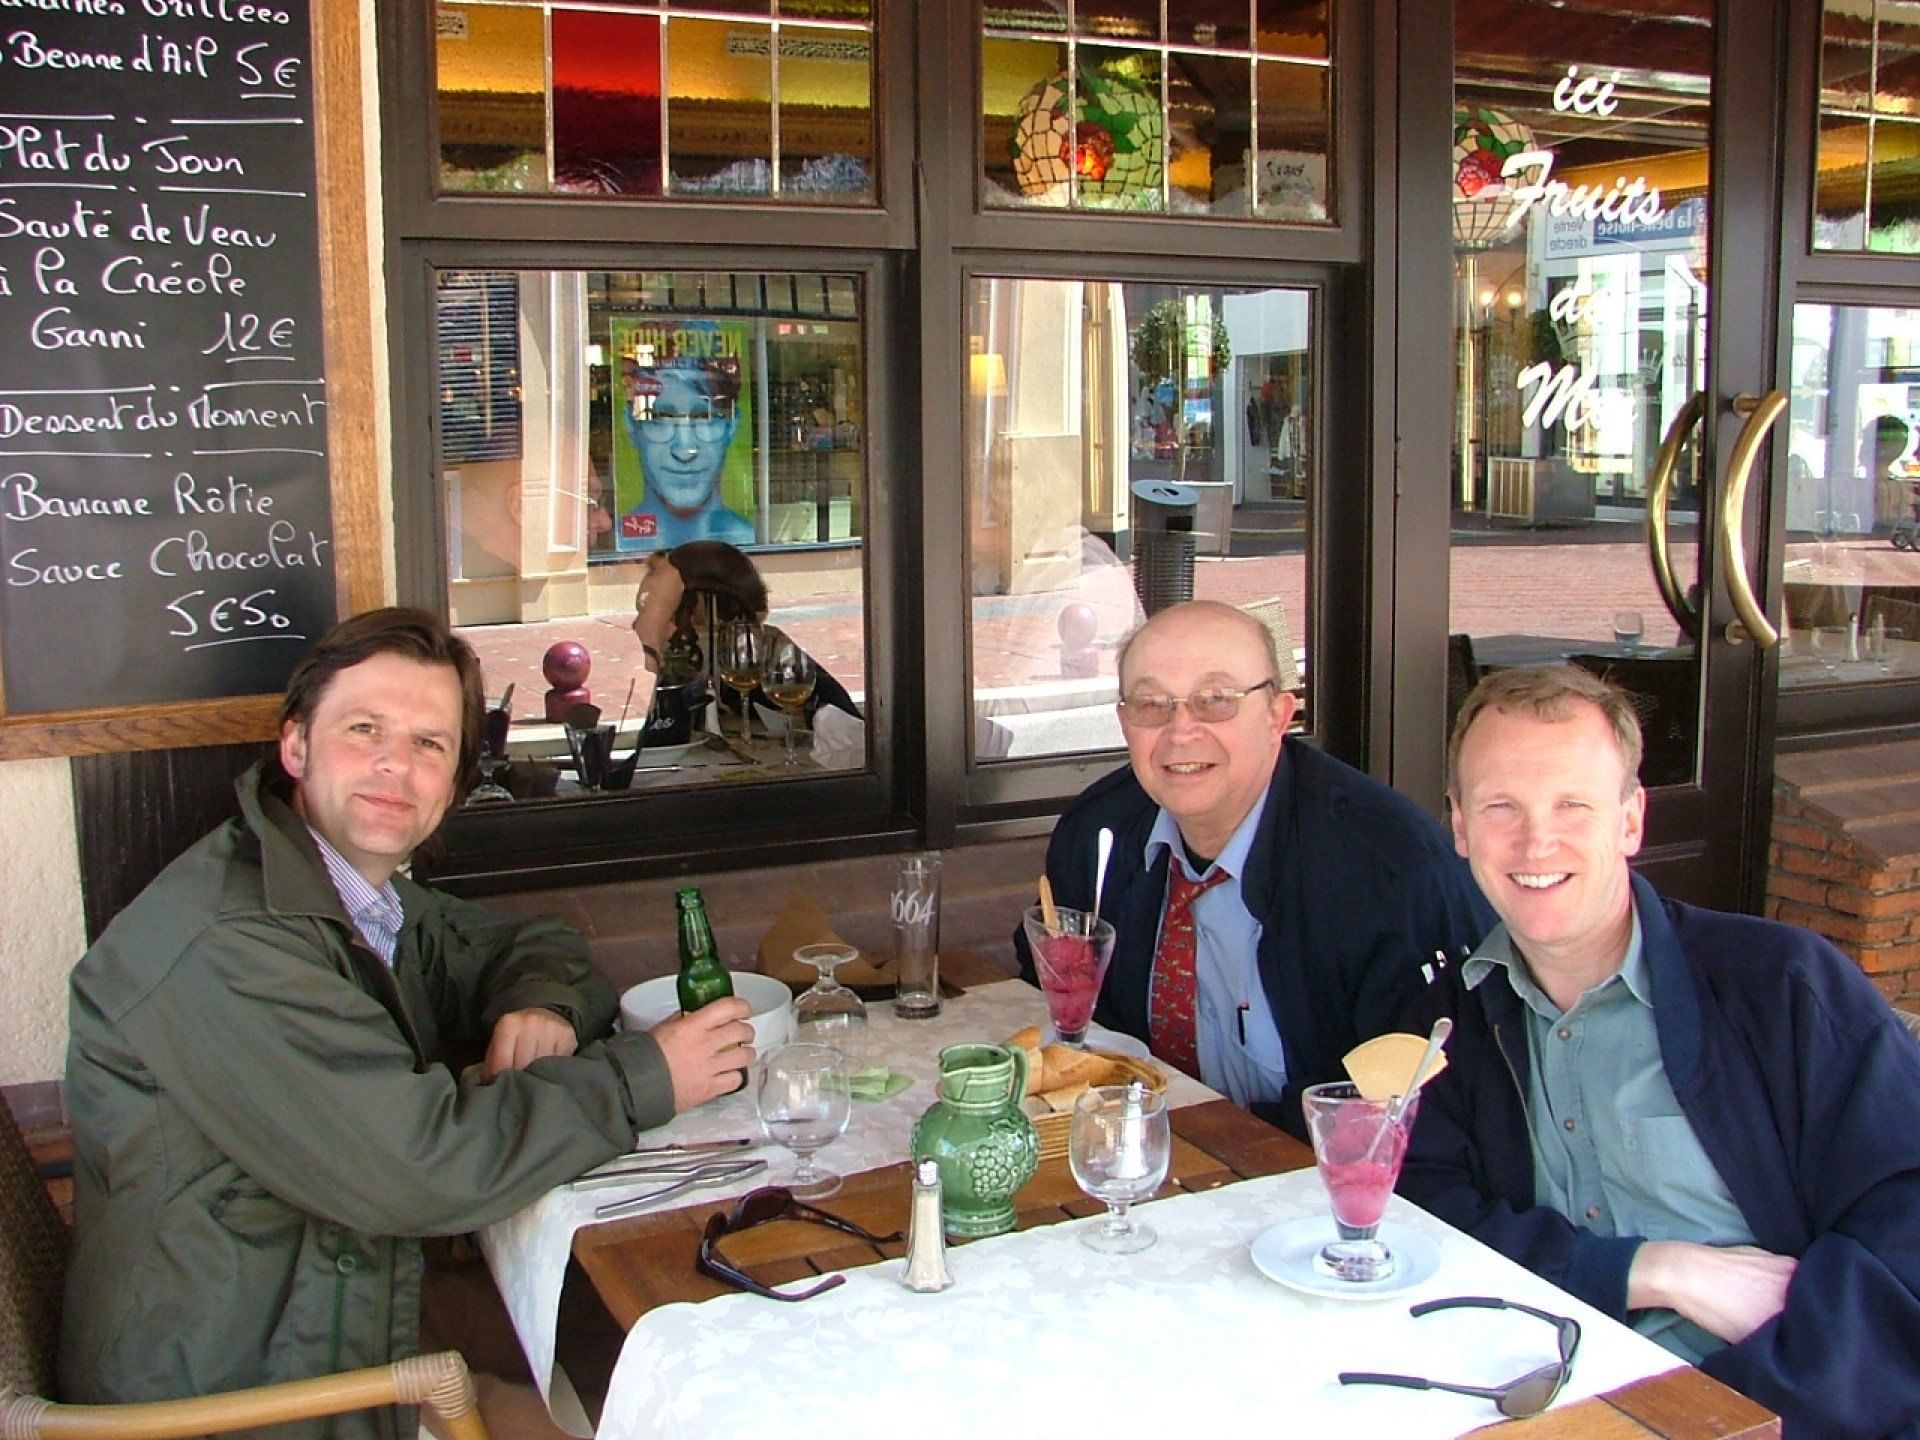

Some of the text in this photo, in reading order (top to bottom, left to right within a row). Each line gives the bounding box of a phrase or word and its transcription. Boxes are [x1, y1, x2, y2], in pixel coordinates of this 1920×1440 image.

[1552, 65, 1622, 117] ici
[84, 133, 130, 172] du
[1500, 150, 1666, 229] Fruits
[0, 198, 277, 248] Sauté de Veau
[35, 247, 78, 295] la
[136, 397, 178, 430] du
[1, 472, 274, 521] Banane Rôtie
[8, 520, 330, 586] Sauce Chocolat
